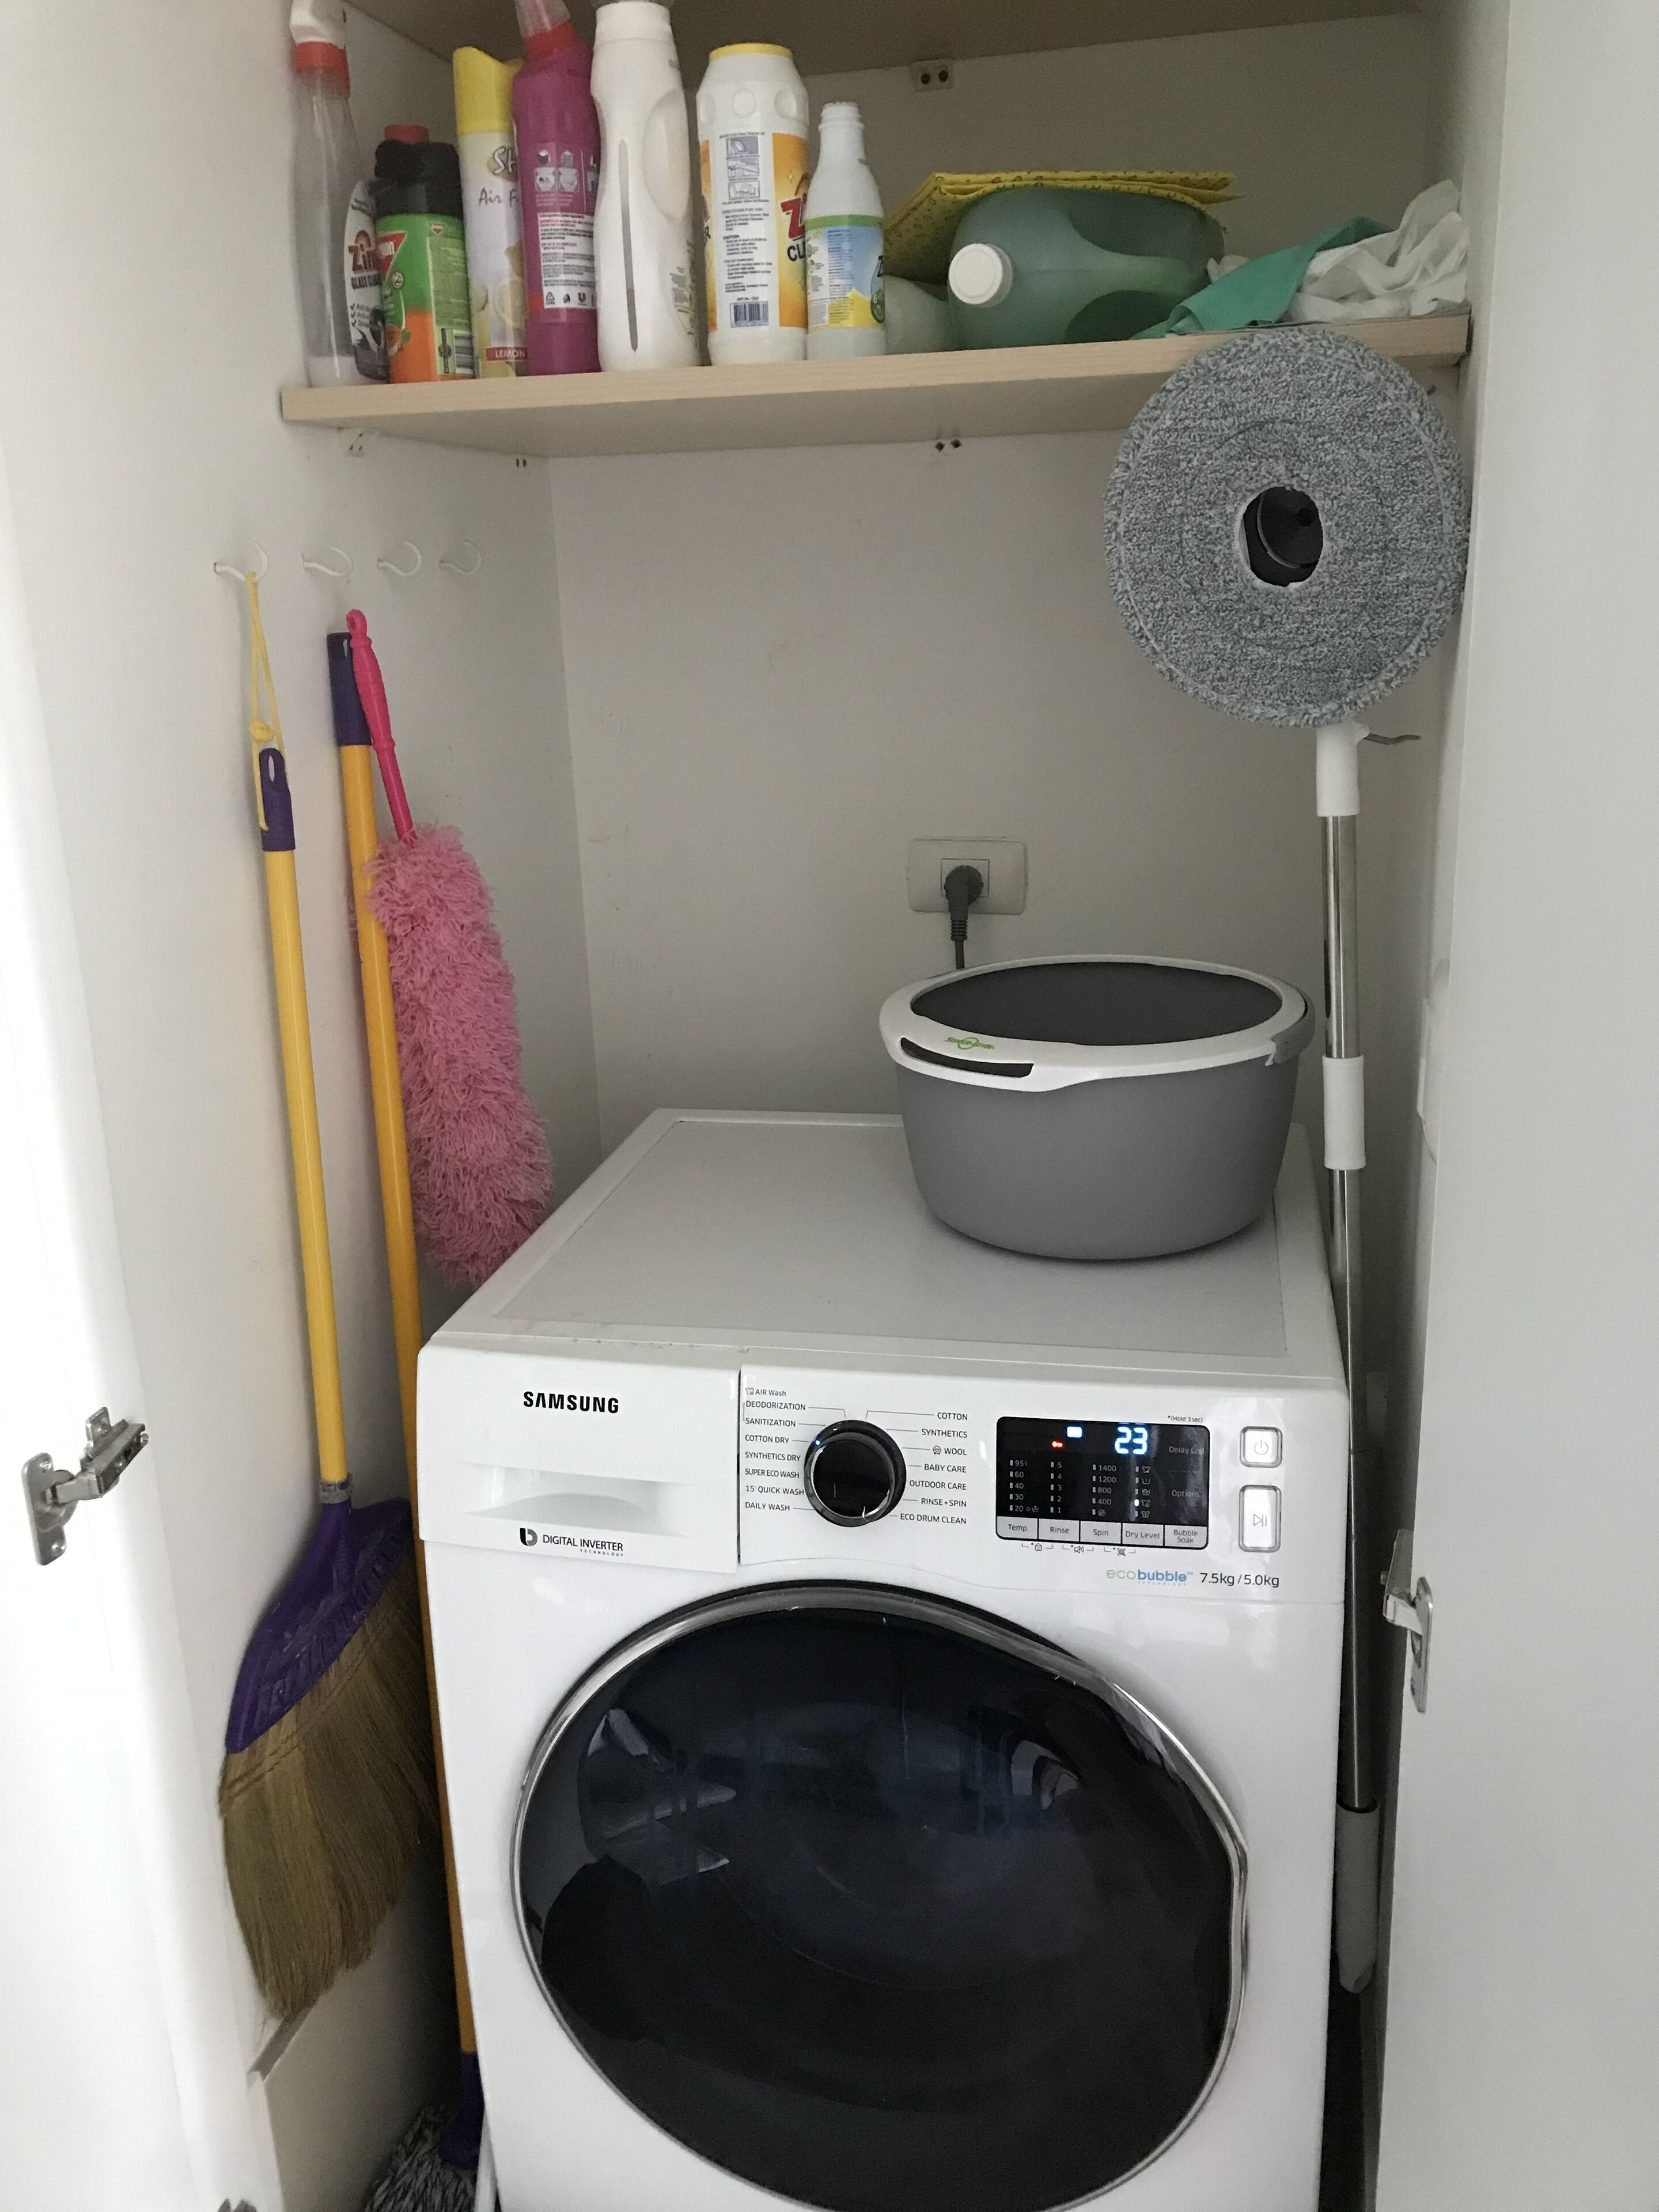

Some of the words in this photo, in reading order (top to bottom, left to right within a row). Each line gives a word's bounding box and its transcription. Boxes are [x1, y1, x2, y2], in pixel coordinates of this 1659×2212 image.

[478, 188, 502, 207] Air
[496, 350, 525, 358] LEMON
[523, 1391, 619, 1414] SAMSUNG
[746, 1400, 806, 1411] DEODORIZATION
[937, 1412, 968, 1421] COTTON
[745, 1418, 796, 1427] SANITIZATION
[922, 1428, 968, 1438] SYNTHETICS
[745, 1434, 773, 1442] COTTON
[1115, 1426, 1148, 1455] 23
[944, 1447, 968, 1456] WOOL
[1169, 1446, 1189, 1455] Delay
[1191, 1446, 1205, 1455] End
[745, 1451, 786, 1461] SYNTHETICS
[924, 1463, 945, 1471] BABY
[946, 1465, 967, 1473] CARE
[745, 1468, 766, 1476] SUPER
[780, 1471, 800, 1479] WASH
[910, 1480, 946, 1489] OUTDOOR
[948, 1482, 967, 1490] CARE
[757, 1486, 781, 1494] QUICK
[782, 1487, 804, 1495] WASH
[1171, 1490, 1200, 1498] Options
[921, 1498, 943, 1506] RINSE
[900, 1513, 915, 1521] ECO
[916, 1514, 940, 1522] DRUM
[941, 1516, 967, 1524] CLEAN
[1008, 1524, 1027, 1532] Temp
[1050, 1526, 1069, 1534] Rinse
[1125, 1531, 1139, 1539] Dry
[1173, 1529, 1198, 1537] Bubble
[543, 1534, 578, 1547] DIGITAL
[580, 1539, 623, 1551] INVERTER
[580, 1548, 623, 1557] TECHNOLOGY
[1200, 1572, 1234, 1586] 7.5kg
[1244, 1574, 1279, 1588] 5.0kg
